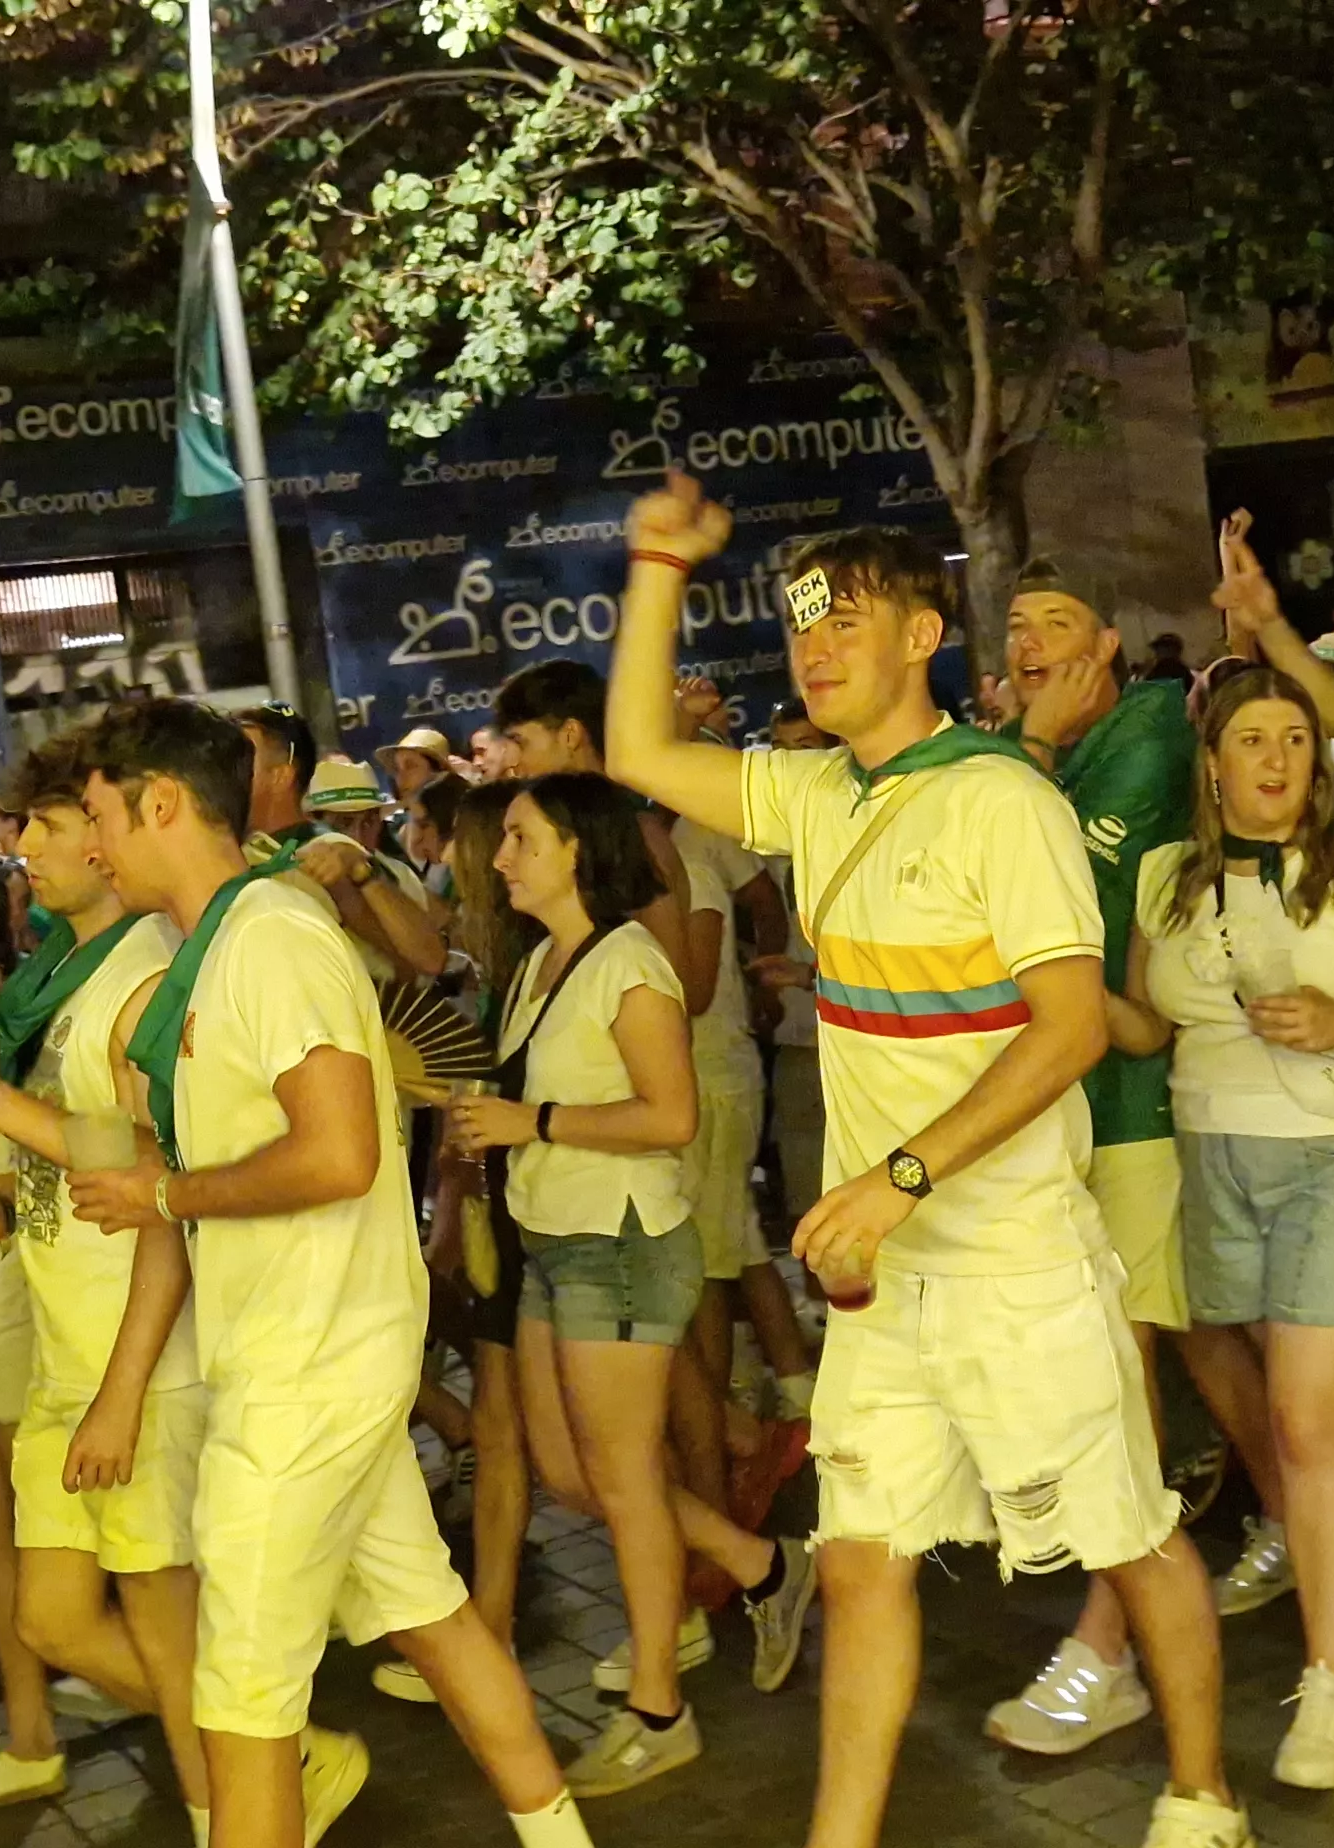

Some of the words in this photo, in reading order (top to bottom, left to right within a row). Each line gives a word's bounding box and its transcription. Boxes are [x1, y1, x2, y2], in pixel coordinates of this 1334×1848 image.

[436, 454, 558, 483] ecomputer
[18, 484, 157, 515] ecomputer
[347, 533, 466, 562] ecomputer
[790, 573, 825, 605] FCK
[797, 593, 831, 625] ZGZ
